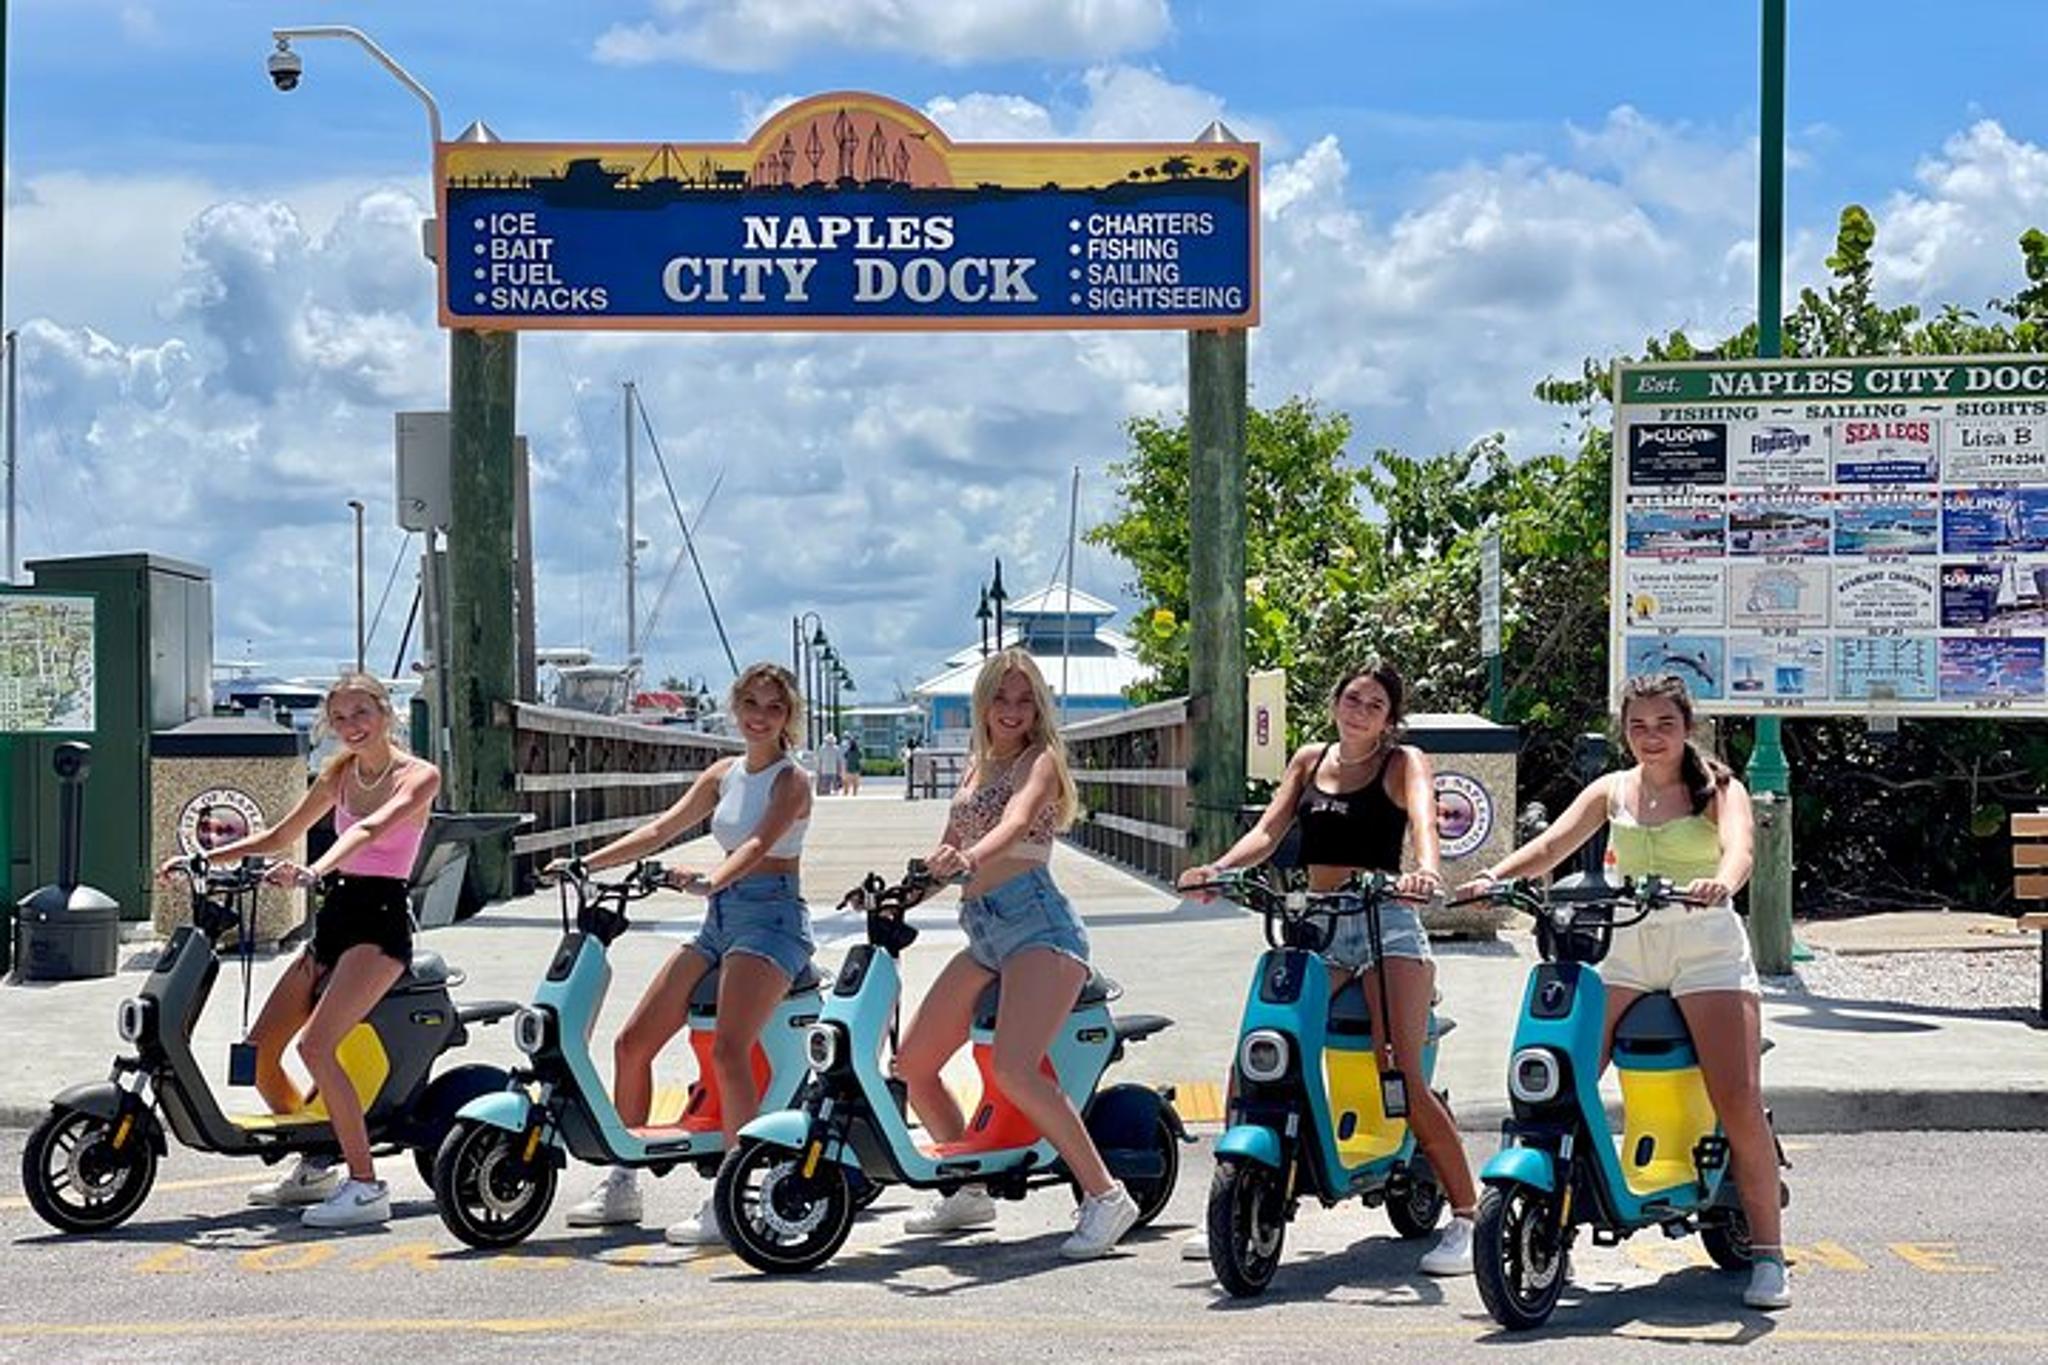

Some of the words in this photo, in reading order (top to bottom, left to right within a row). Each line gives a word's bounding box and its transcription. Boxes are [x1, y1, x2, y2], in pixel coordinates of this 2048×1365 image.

[491, 214, 536, 234] ICE
[742, 216, 955, 249] NAPLES
[1087, 213, 1215, 235] CHARTERS
[491, 239, 553, 259] BAIT
[1088, 239, 1179, 260] FISHING
[491, 264, 562, 285] FUEL
[662, 257, 818, 302] CITY
[853, 257, 1038, 302] DOCK
[1087, 263, 1179, 285] SAILING
[491, 288, 609, 310] SNACKS
[1087, 288, 1242, 310] SIGHTSEEING
[1636, 376, 1682, 394] Est.
[1709, 371, 1854, 395] NAPLES
[1864, 369, 1955, 394] CITY
[1965, 366, 2048, 391] DOC
[1660, 406, 1759, 421] FISHING
[1805, 403, 1908, 419] SAILING
[1956, 401, 2047, 416] SIGHTS
[1845, 423, 1881, 444] SEA
[1885, 422, 1930, 444] LEGS
[1962, 428, 2006, 447] Lisa
